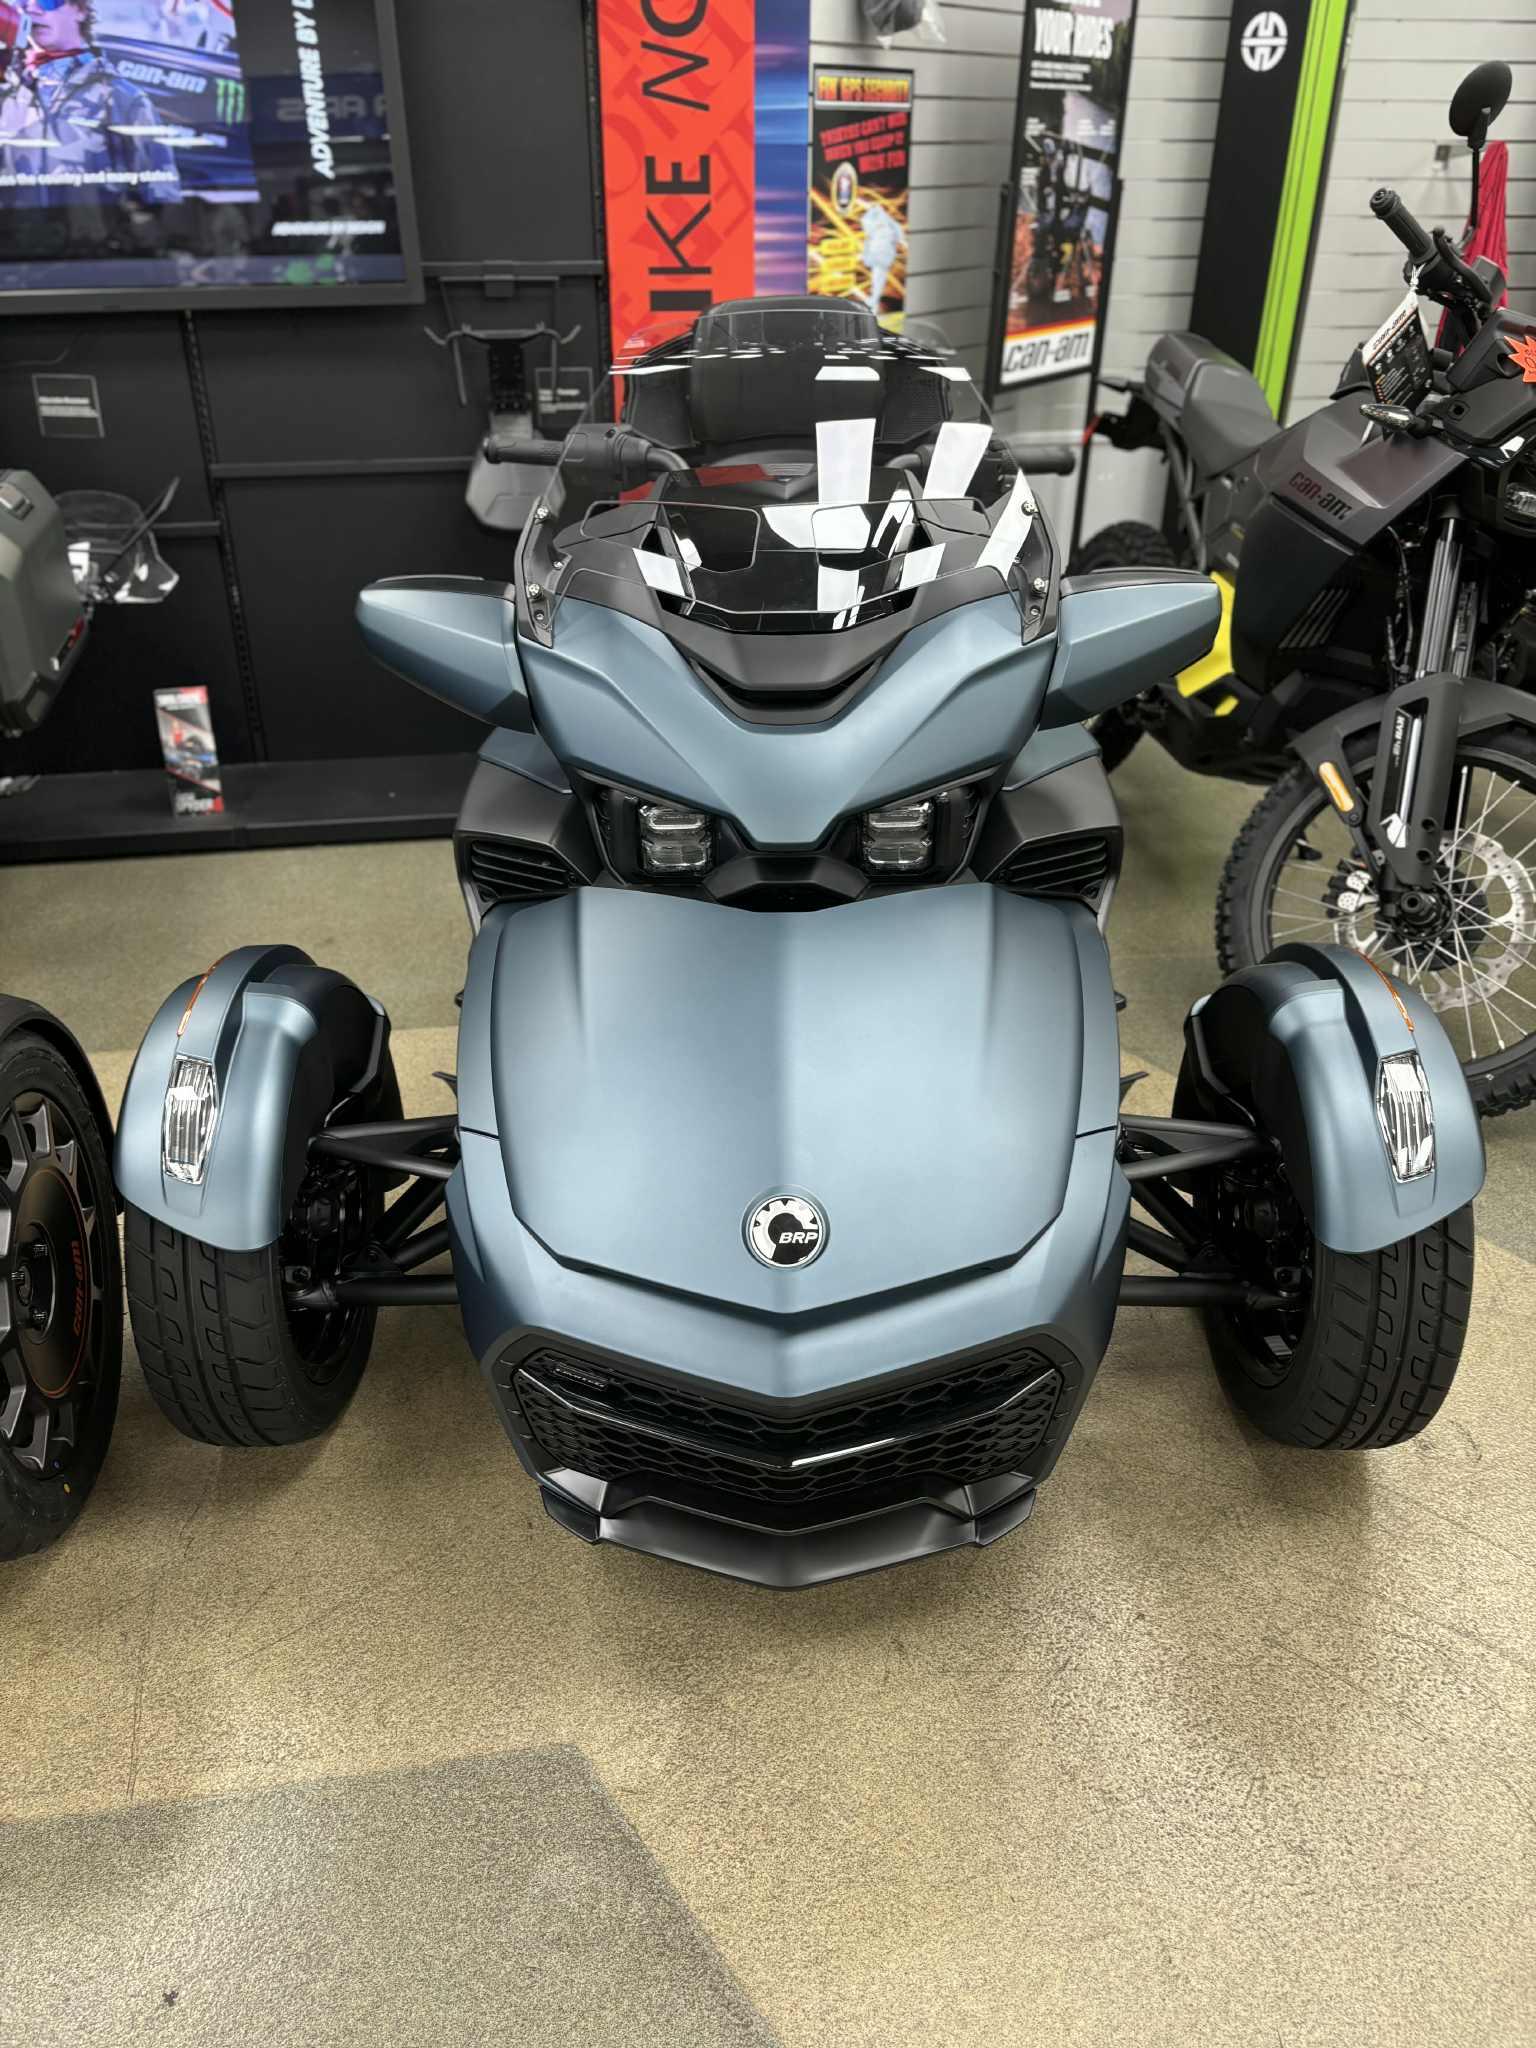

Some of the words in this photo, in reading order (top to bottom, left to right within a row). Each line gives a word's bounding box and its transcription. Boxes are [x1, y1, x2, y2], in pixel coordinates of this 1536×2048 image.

[292, 11, 318, 45] BY
[1034, 7, 1074, 56] YOUR
[1072, 12, 1115, 60] RIDES
[116, 60, 207, 94] can-am
[297, 47, 336, 180] ADVENTURE
[83, 170, 105, 184] and
[1002, 332, 1089, 373] can-am
[1289, 471, 1352, 521] can-am
[778, 1231, 819, 1244] BRP
